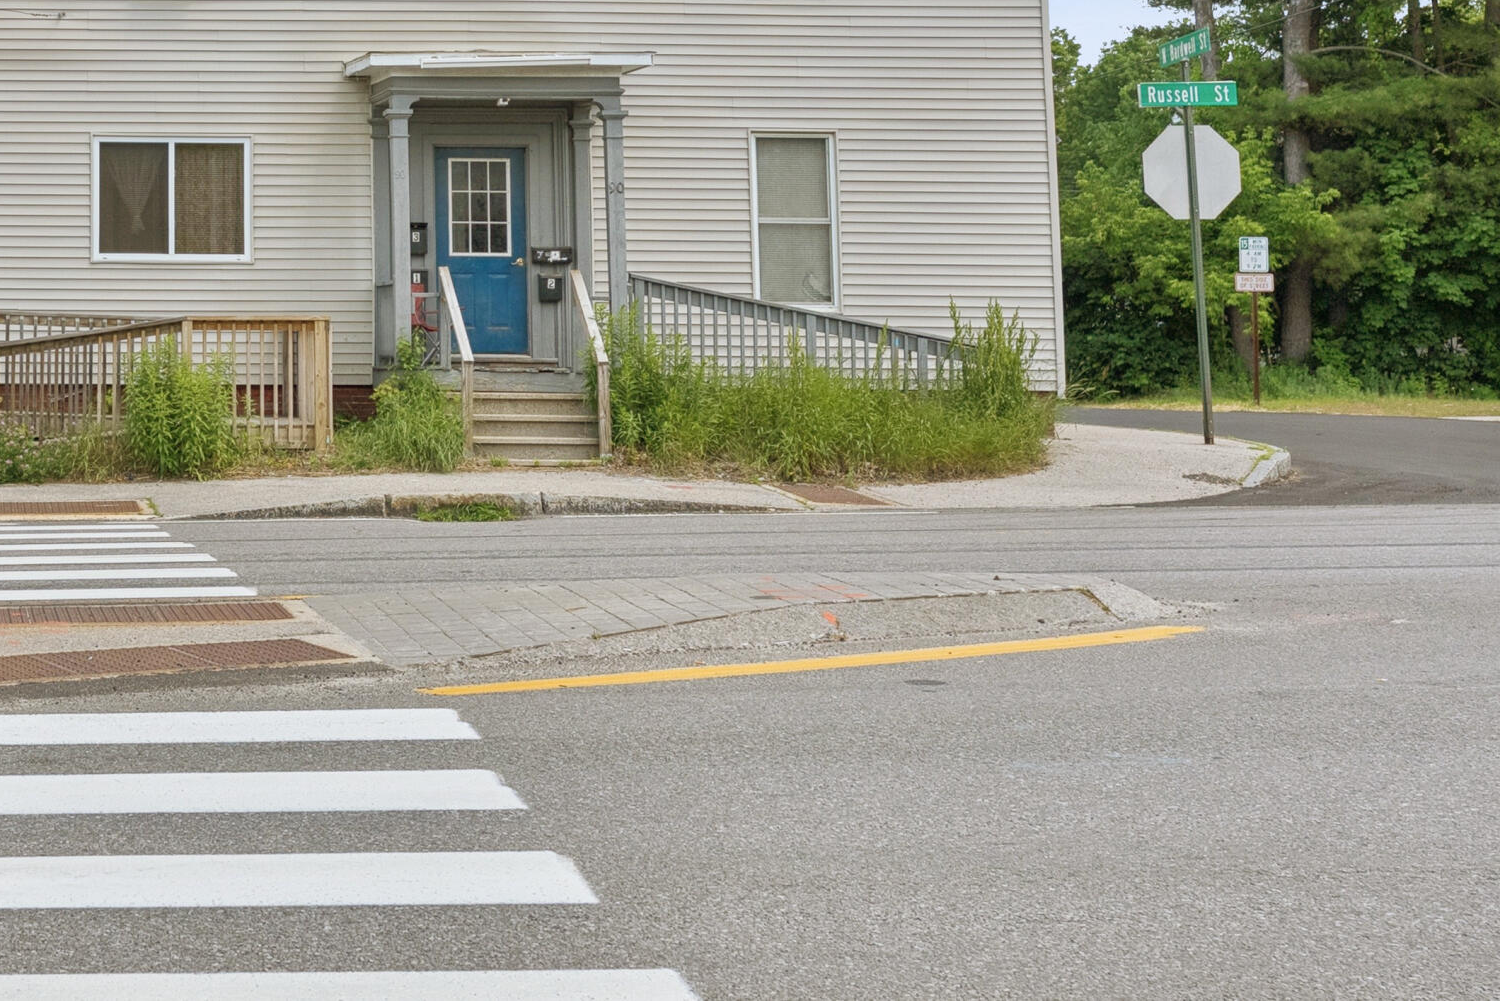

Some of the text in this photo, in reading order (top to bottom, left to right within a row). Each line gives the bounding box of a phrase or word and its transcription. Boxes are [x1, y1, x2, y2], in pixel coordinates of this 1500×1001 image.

[1199, 32, 1207, 50] St
[1147, 85, 1230, 103] Russell St
[609, 181, 624, 194] 90
[413, 232, 419, 242] 3
[548, 279, 555, 288] 2
